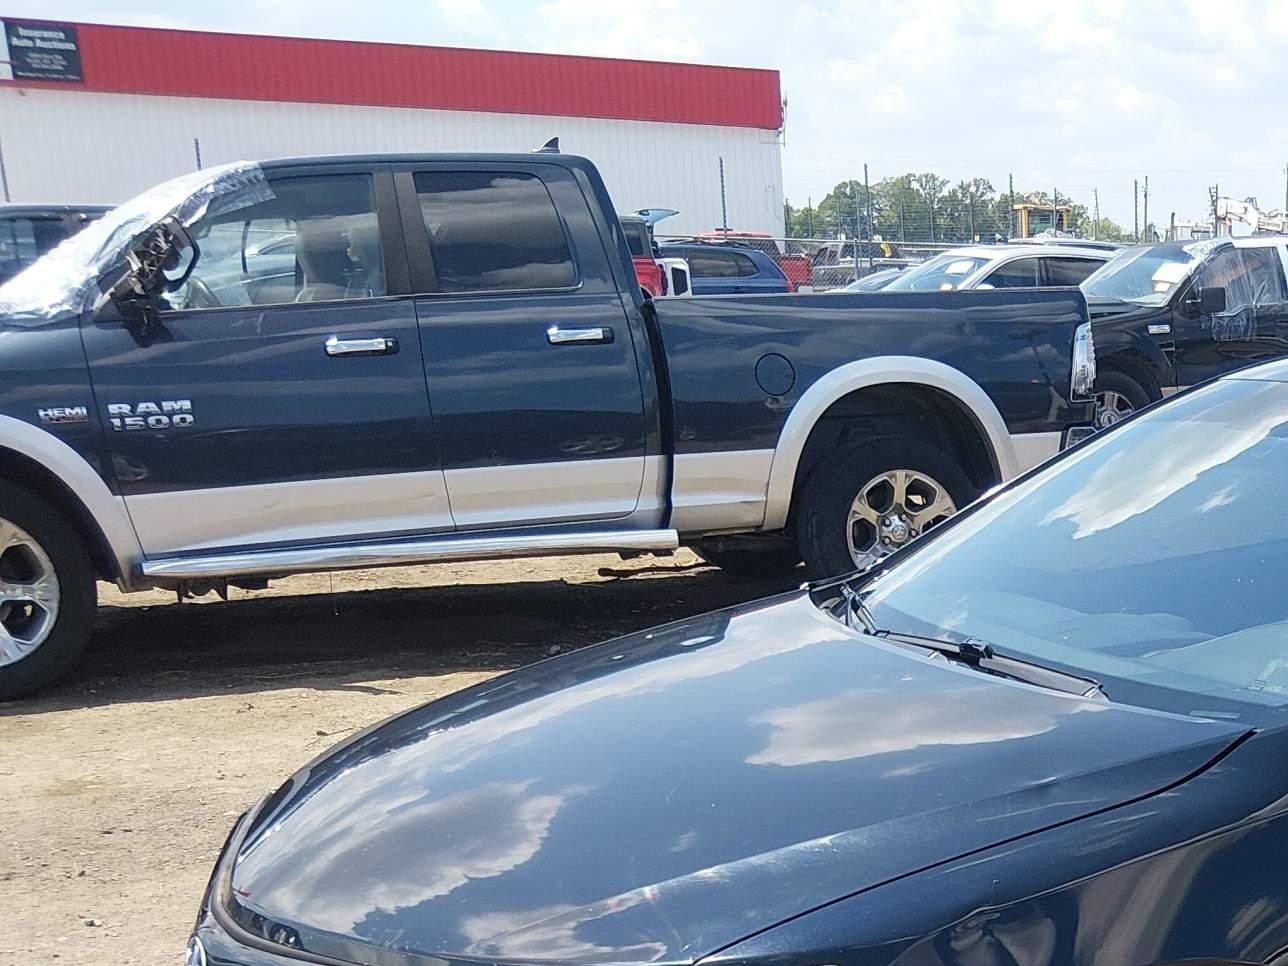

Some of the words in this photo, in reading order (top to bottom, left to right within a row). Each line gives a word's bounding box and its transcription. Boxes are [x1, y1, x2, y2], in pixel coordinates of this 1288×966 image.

[38, 407, 88, 418] HEMI
[107, 400, 192, 417] RAM
[110, 414, 195, 431] 1500
